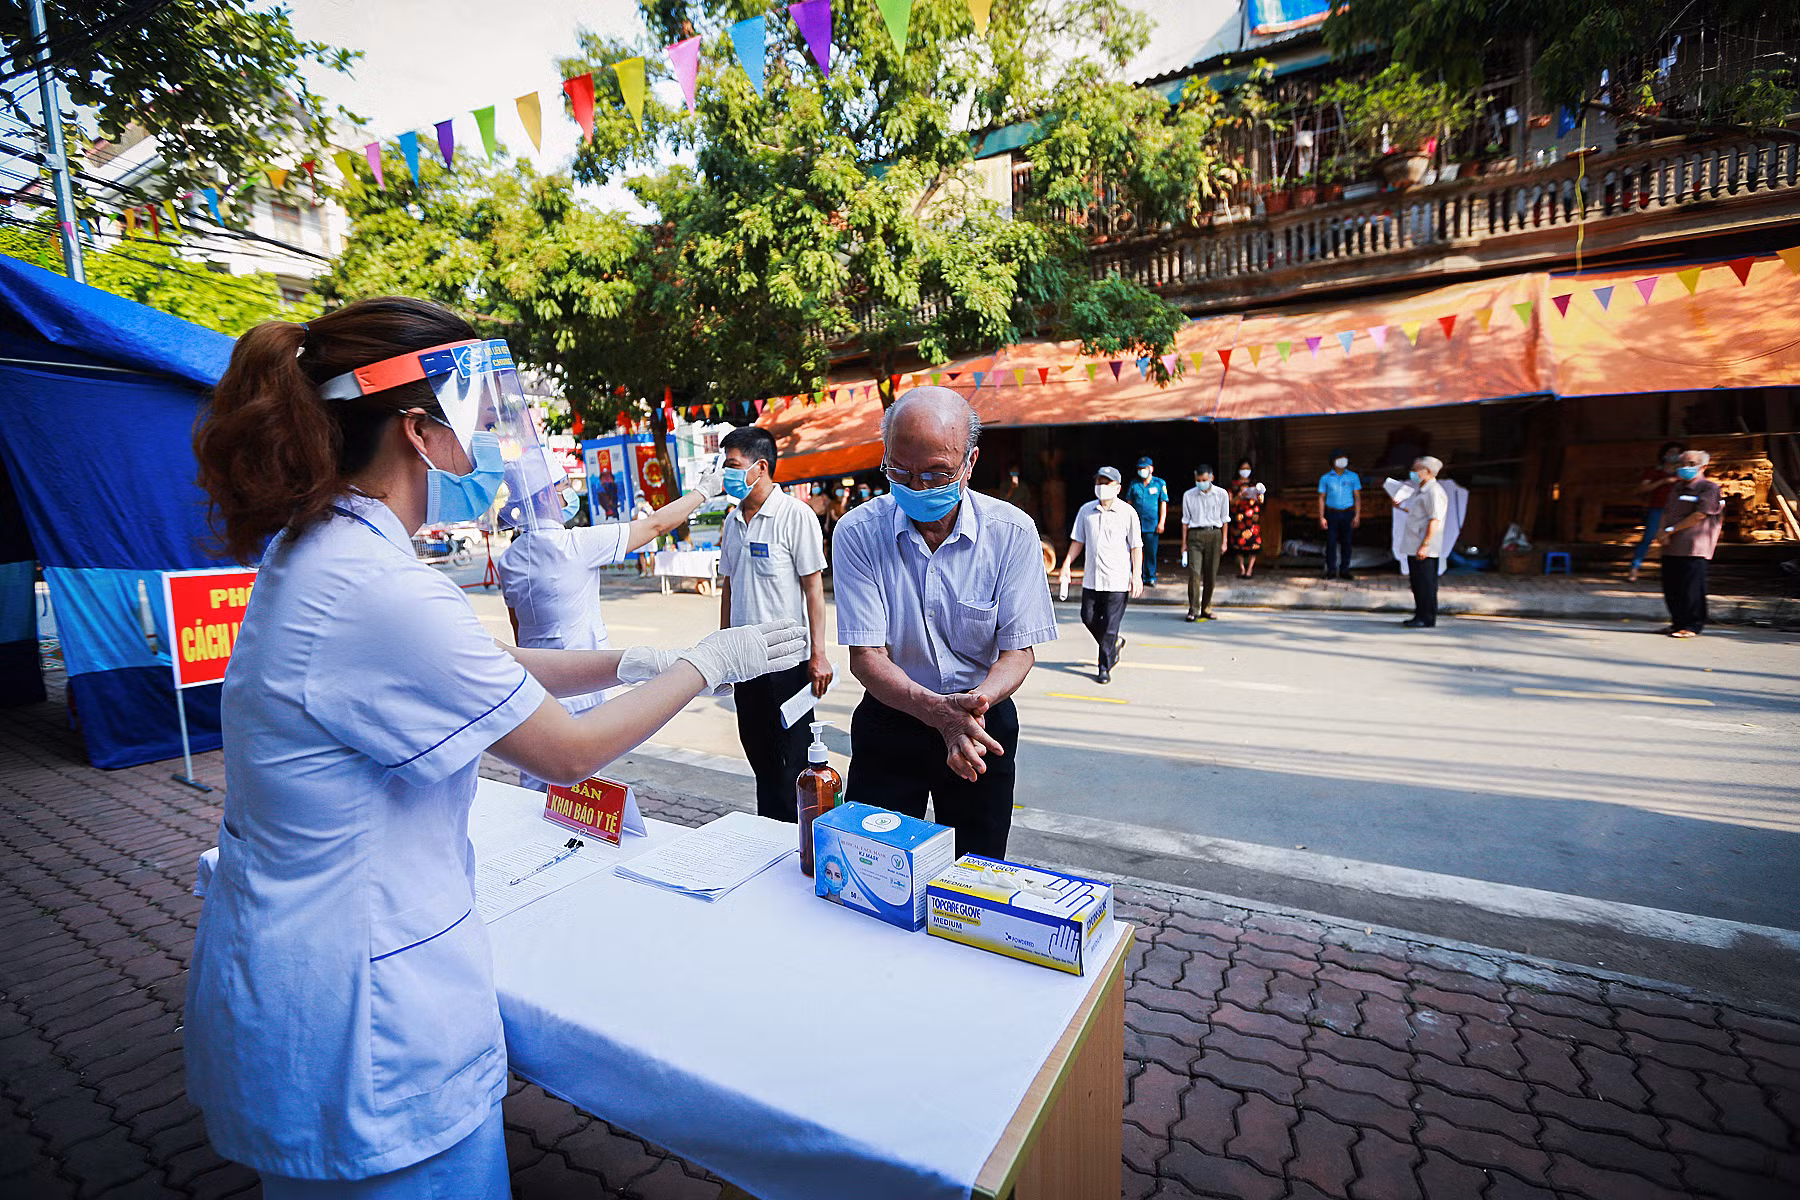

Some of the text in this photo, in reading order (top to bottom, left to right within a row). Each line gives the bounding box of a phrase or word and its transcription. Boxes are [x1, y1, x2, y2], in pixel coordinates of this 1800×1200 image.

[181, 618, 231, 662] CÁCH
[570, 783, 602, 800] BÀN
[550, 795, 620, 833] KHAI BÁO Y TẾ
[866, 853, 879, 861] MASK
[939, 878, 972, 889] MEDIUM
[931, 896, 981, 920] TOPCARE GLOVE
[933, 916, 963, 929] MEDIUM
